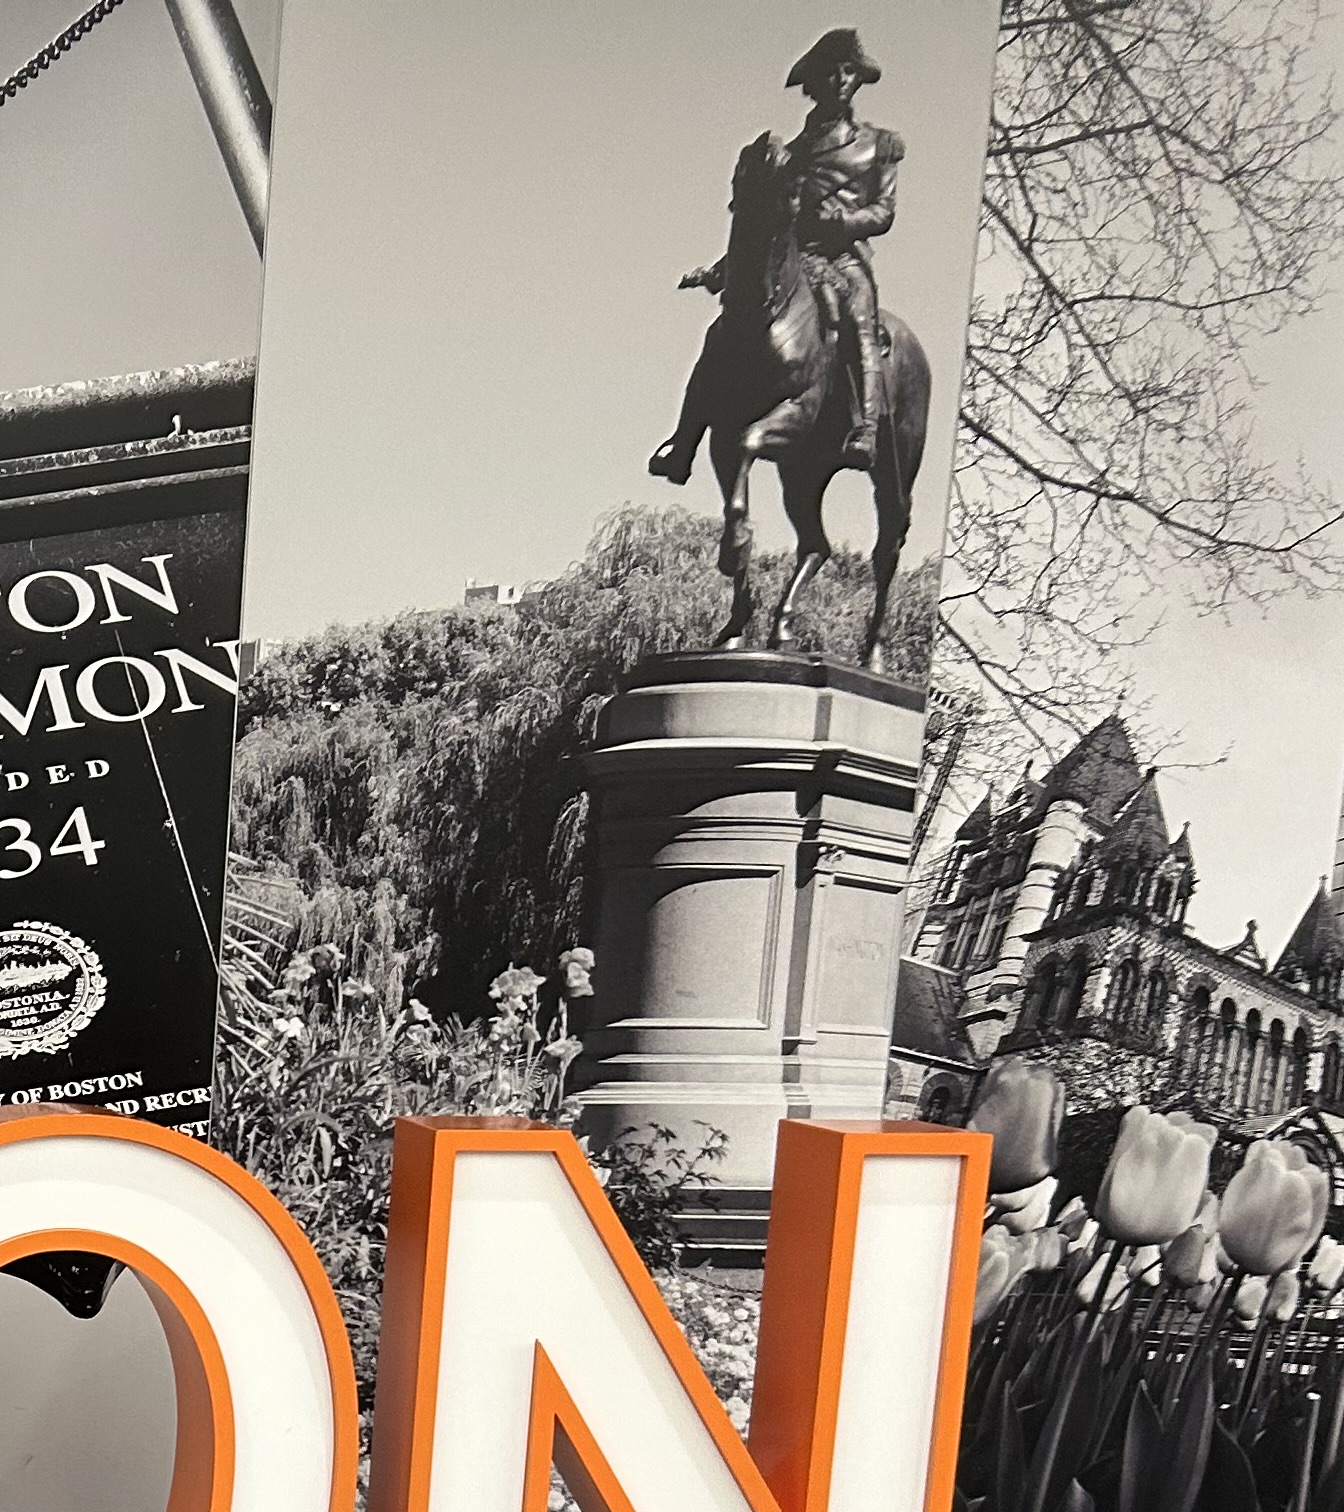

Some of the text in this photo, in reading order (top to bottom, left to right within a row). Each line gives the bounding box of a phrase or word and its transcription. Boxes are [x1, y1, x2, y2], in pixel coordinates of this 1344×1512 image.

[11, 1087, 44, 1104] OF
[47, 1070, 144, 1101] BOSTON
[96, 1086, 212, 1115] ND RECR
